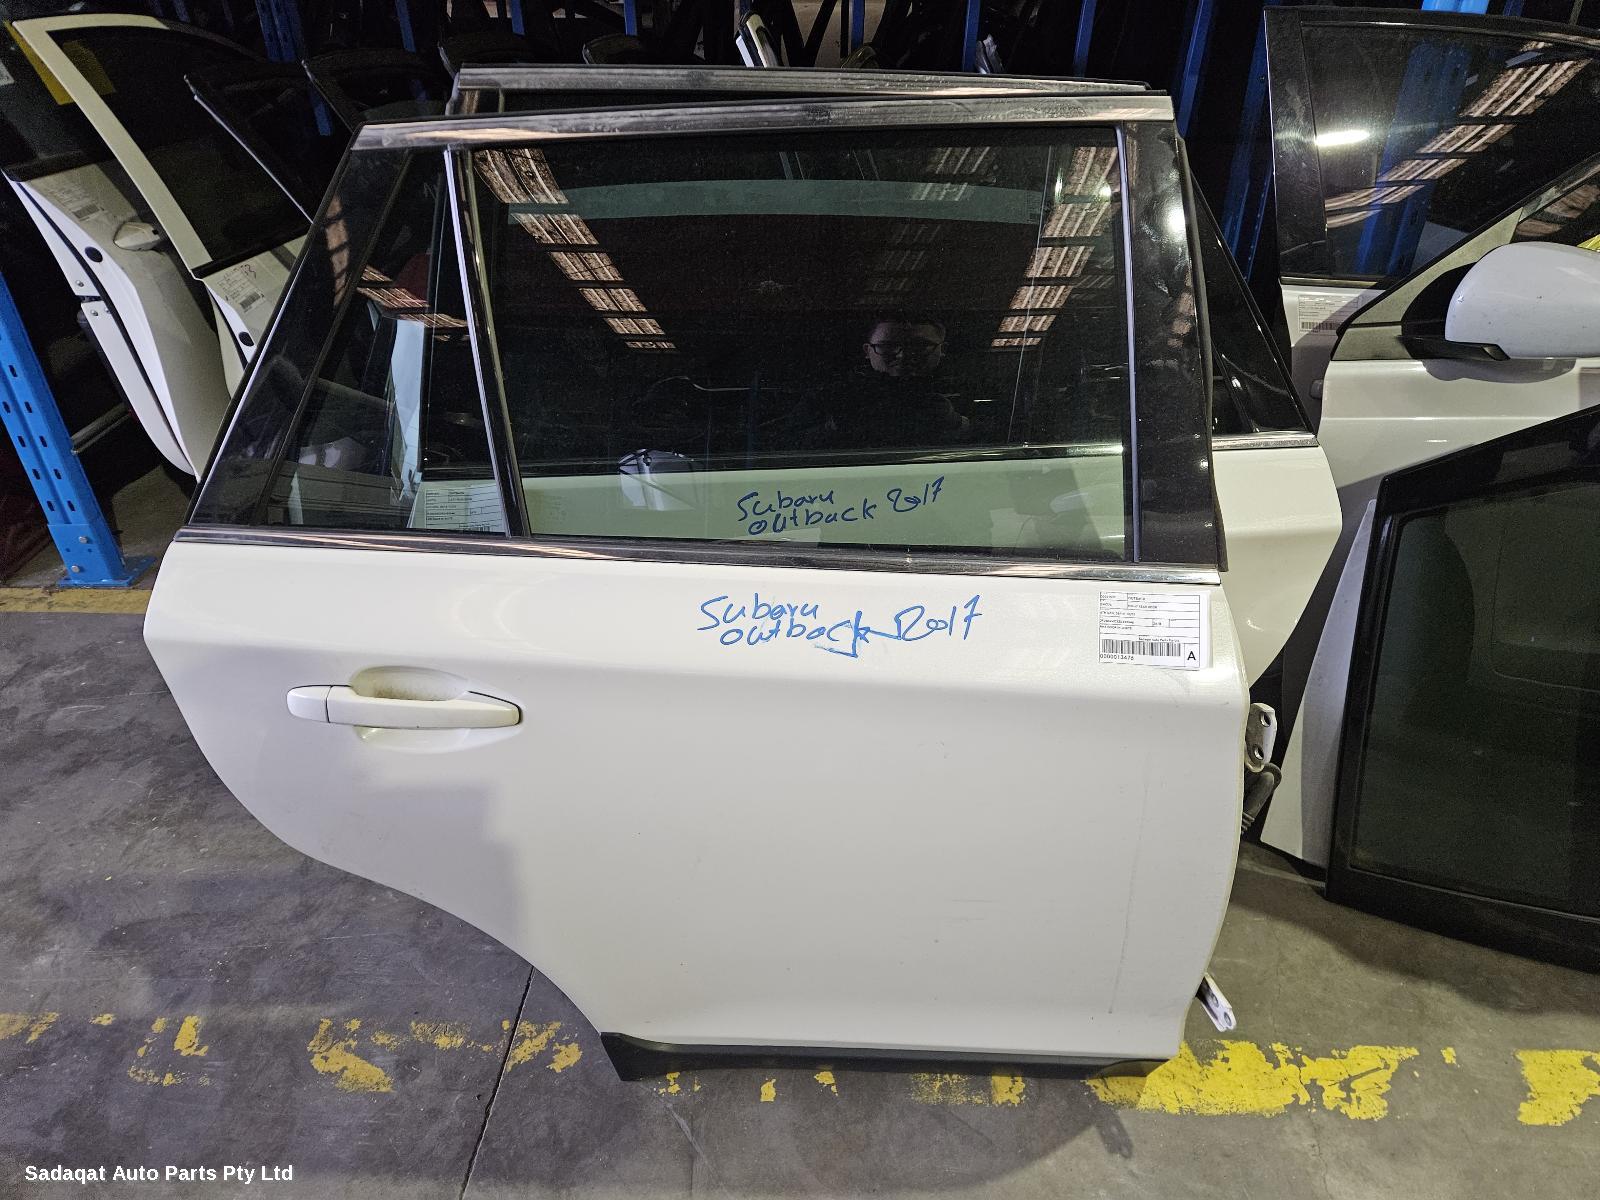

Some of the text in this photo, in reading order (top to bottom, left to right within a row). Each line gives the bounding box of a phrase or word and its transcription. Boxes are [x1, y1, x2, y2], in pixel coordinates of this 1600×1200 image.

[737, 490, 834, 521] Subaru
[697, 593, 819, 630] Subaru
[1187, 650, 1196, 661] A
